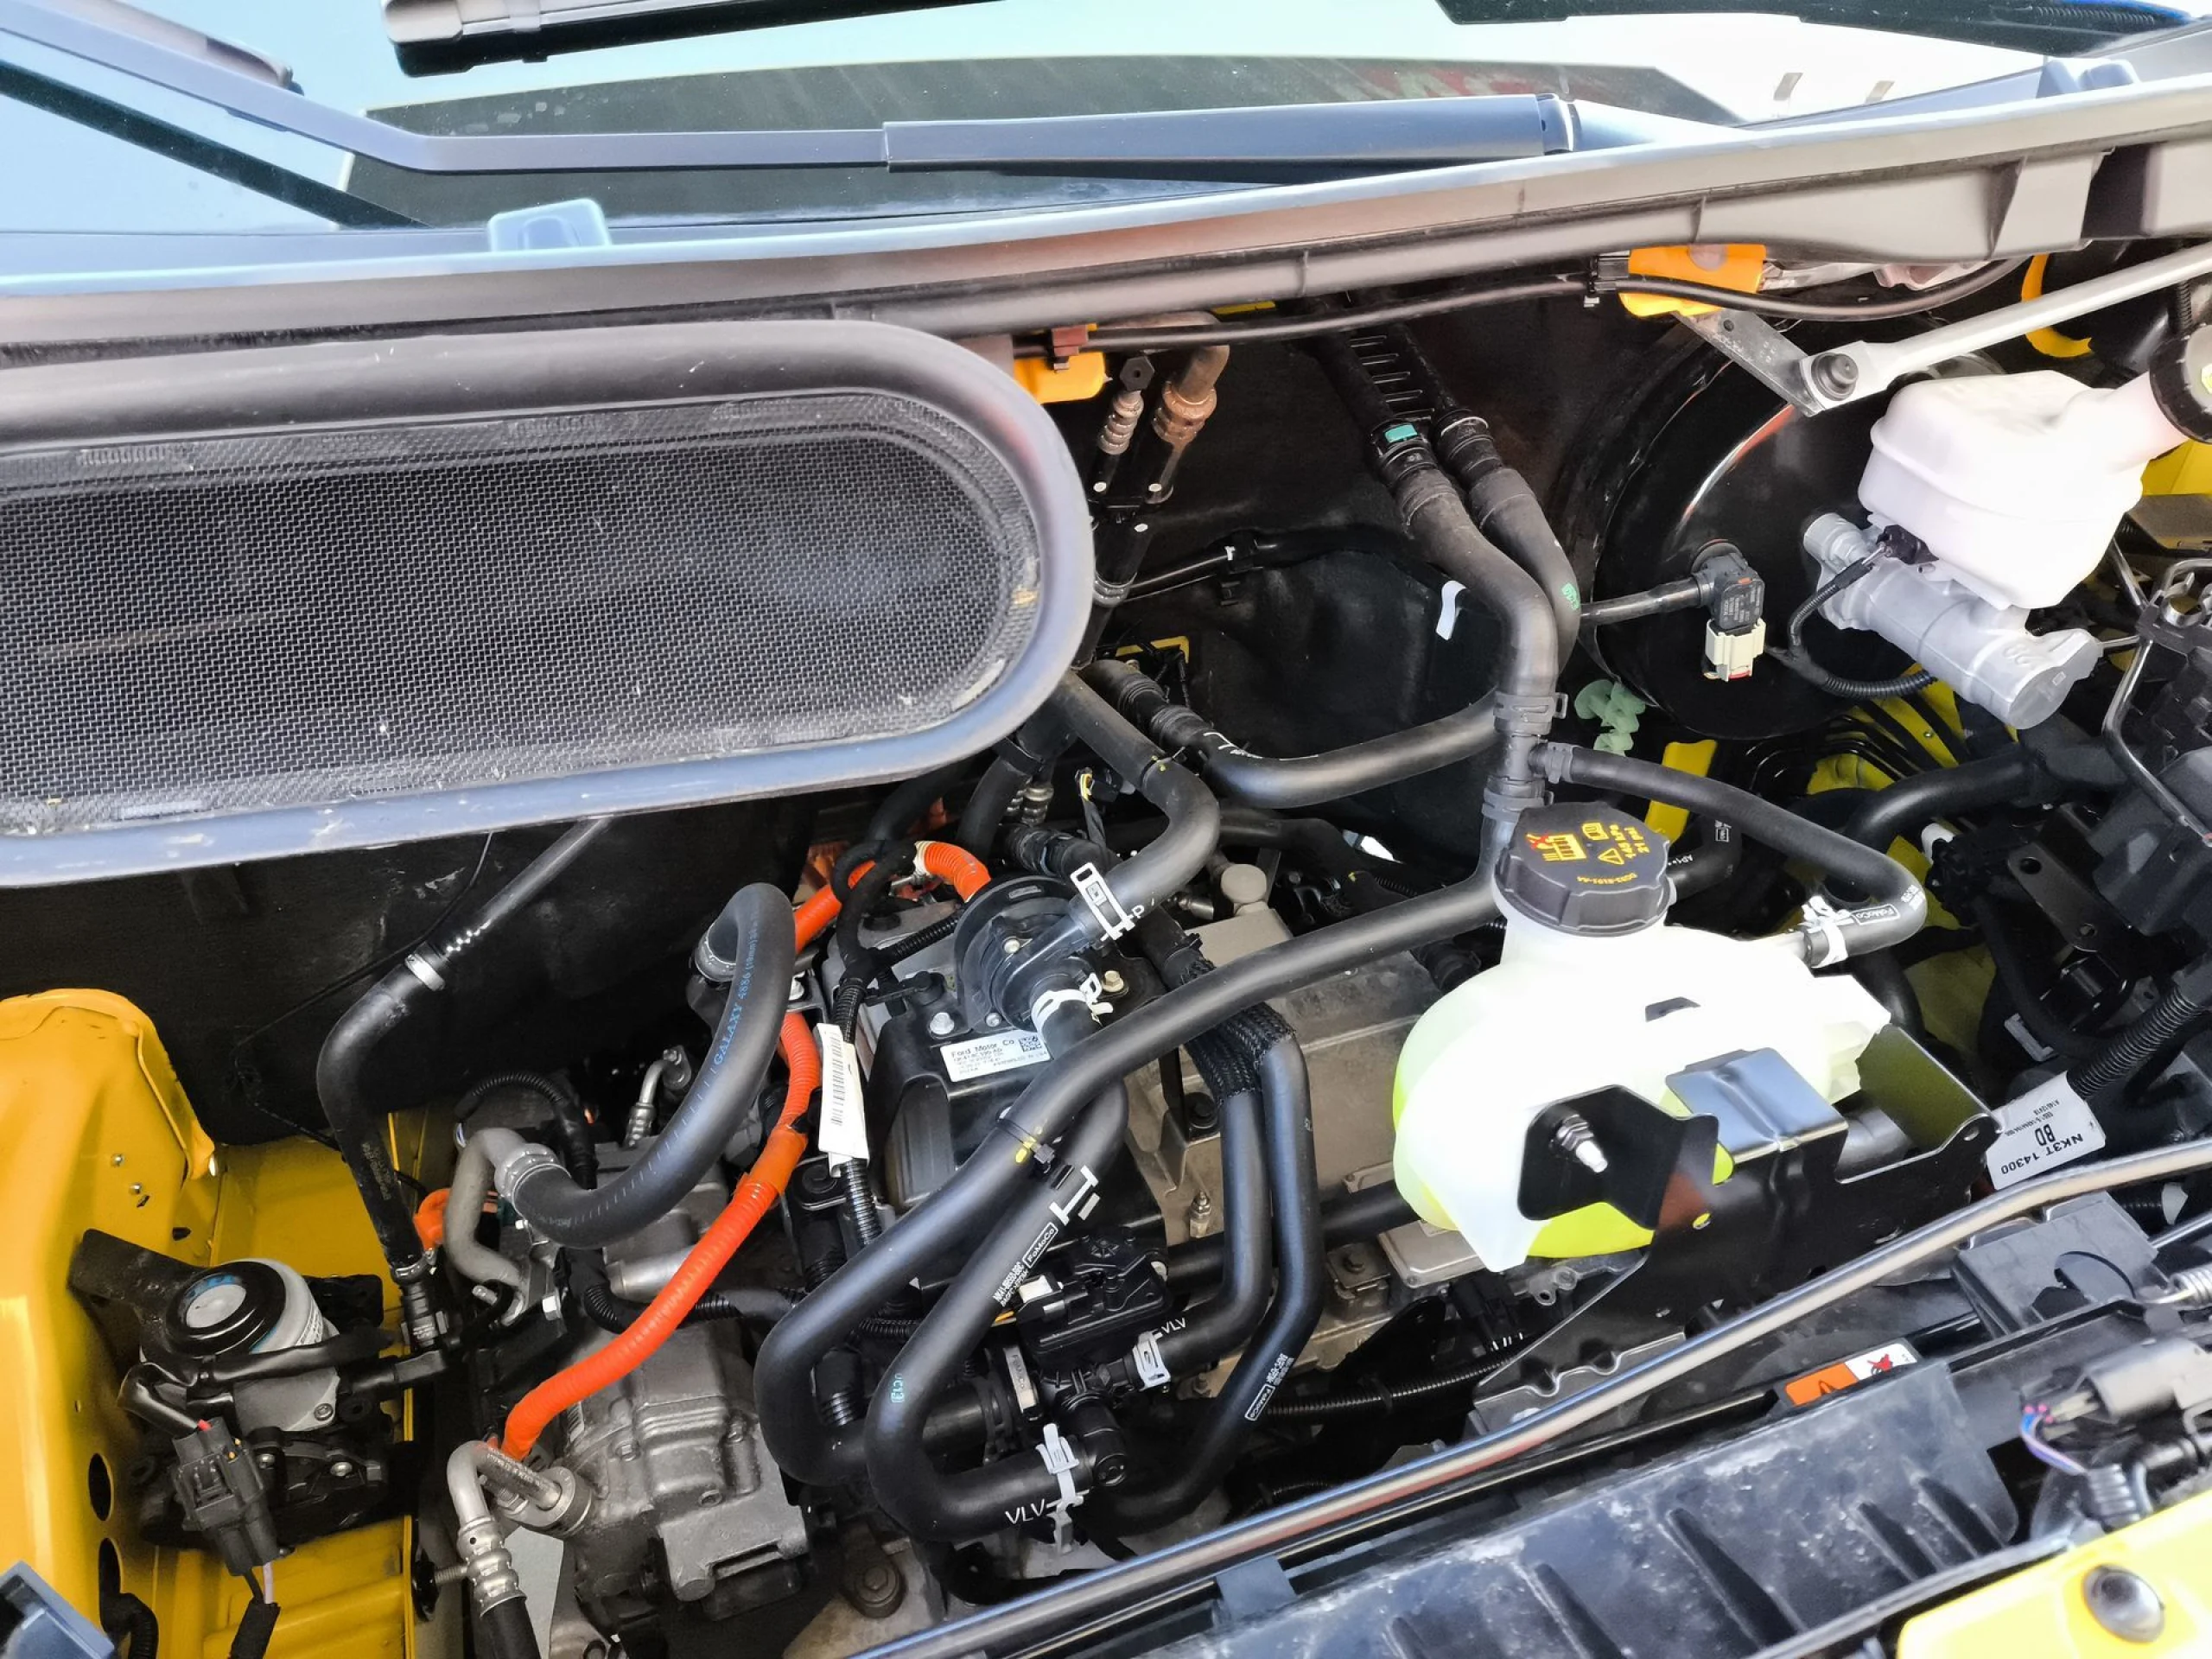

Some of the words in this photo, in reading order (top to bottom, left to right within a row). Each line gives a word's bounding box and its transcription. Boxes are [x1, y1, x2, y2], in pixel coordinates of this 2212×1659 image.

[713, 1002, 742, 1065] GALAXY
[738, 972, 752, 1000] 4886
[951, 1048, 972, 1058] Ford
[974, 1043, 997, 1052] Motor
[2035, 1123, 2056, 1147] BD
[2045, 1133, 2084, 1156] NK3T
[2000, 1153, 2040, 1174] 14300
[1027, 1228, 1055, 1262] FoMoCo
[1160, 1317, 1187, 1334] VLV
[1004, 1498, 1046, 1525] VLV
